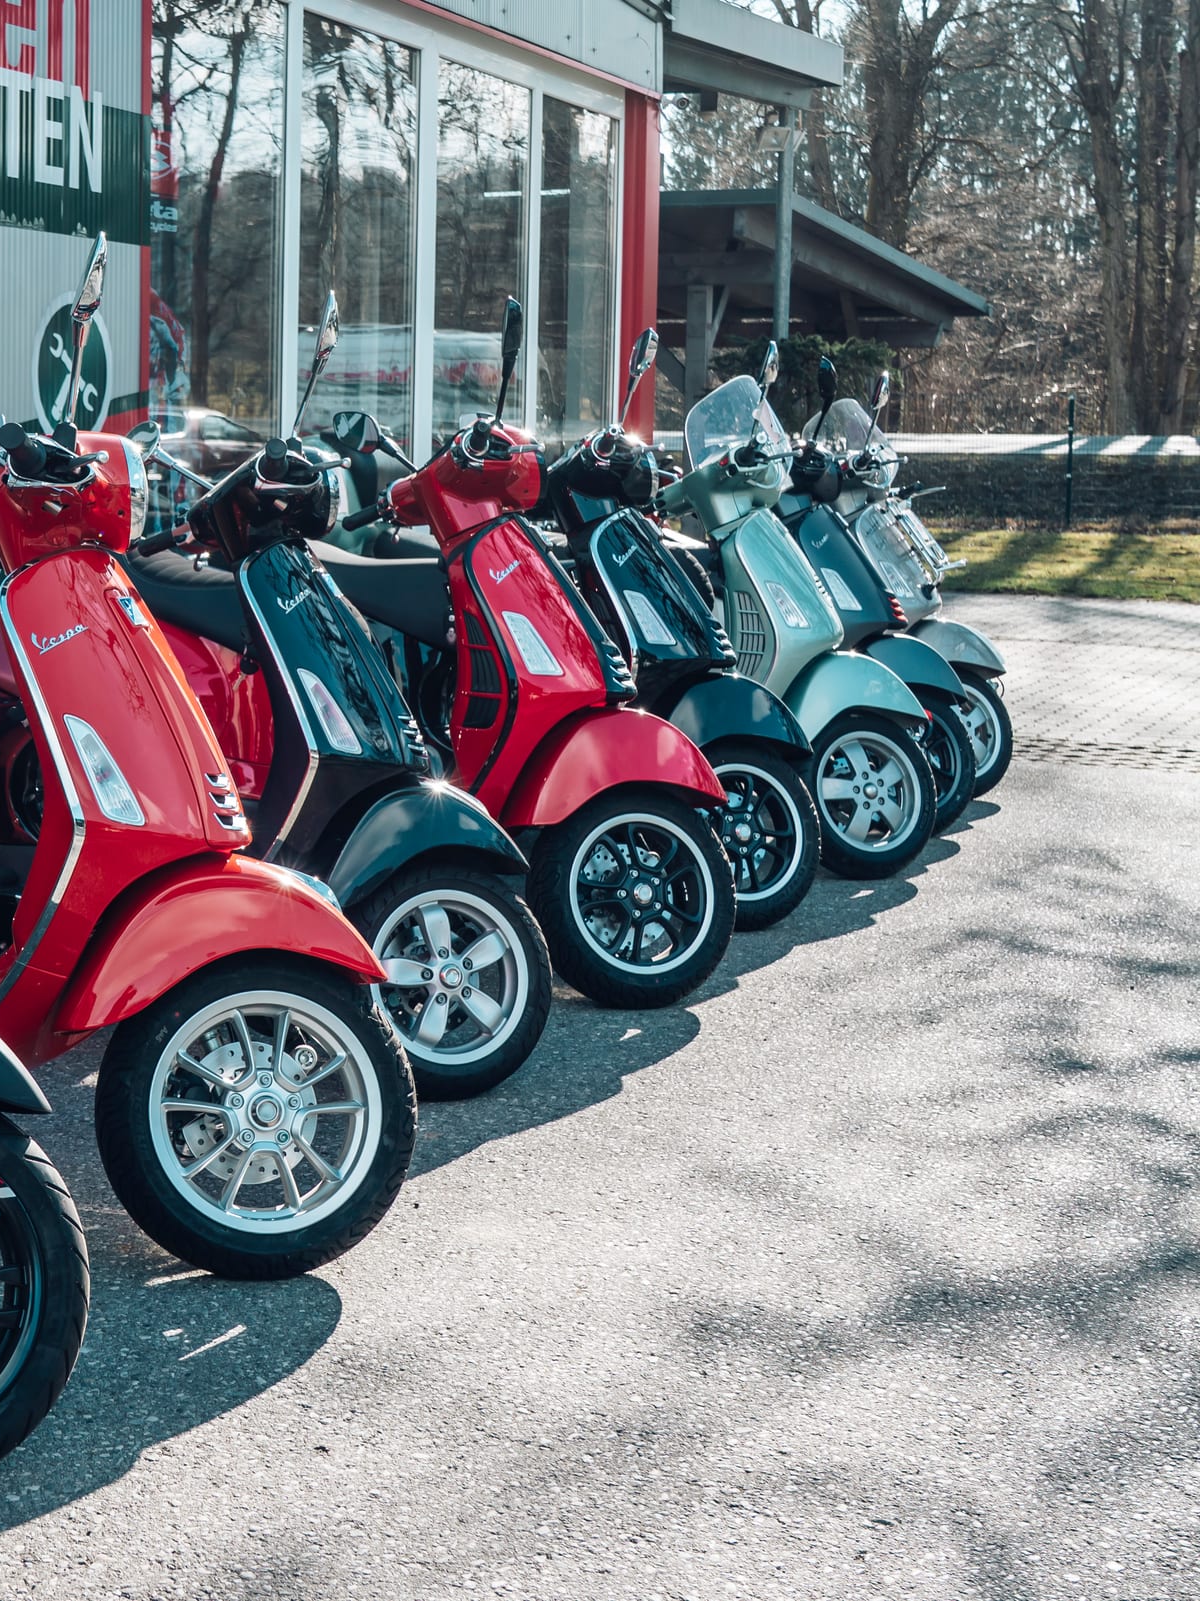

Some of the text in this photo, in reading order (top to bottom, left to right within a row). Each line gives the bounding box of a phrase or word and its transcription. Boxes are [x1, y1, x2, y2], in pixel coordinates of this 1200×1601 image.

[612, 544, 638, 567] Vespa
[488, 559, 521, 585] Vespa
[276, 588, 314, 615] Vespa
[31, 623, 89, 656] Vespa
